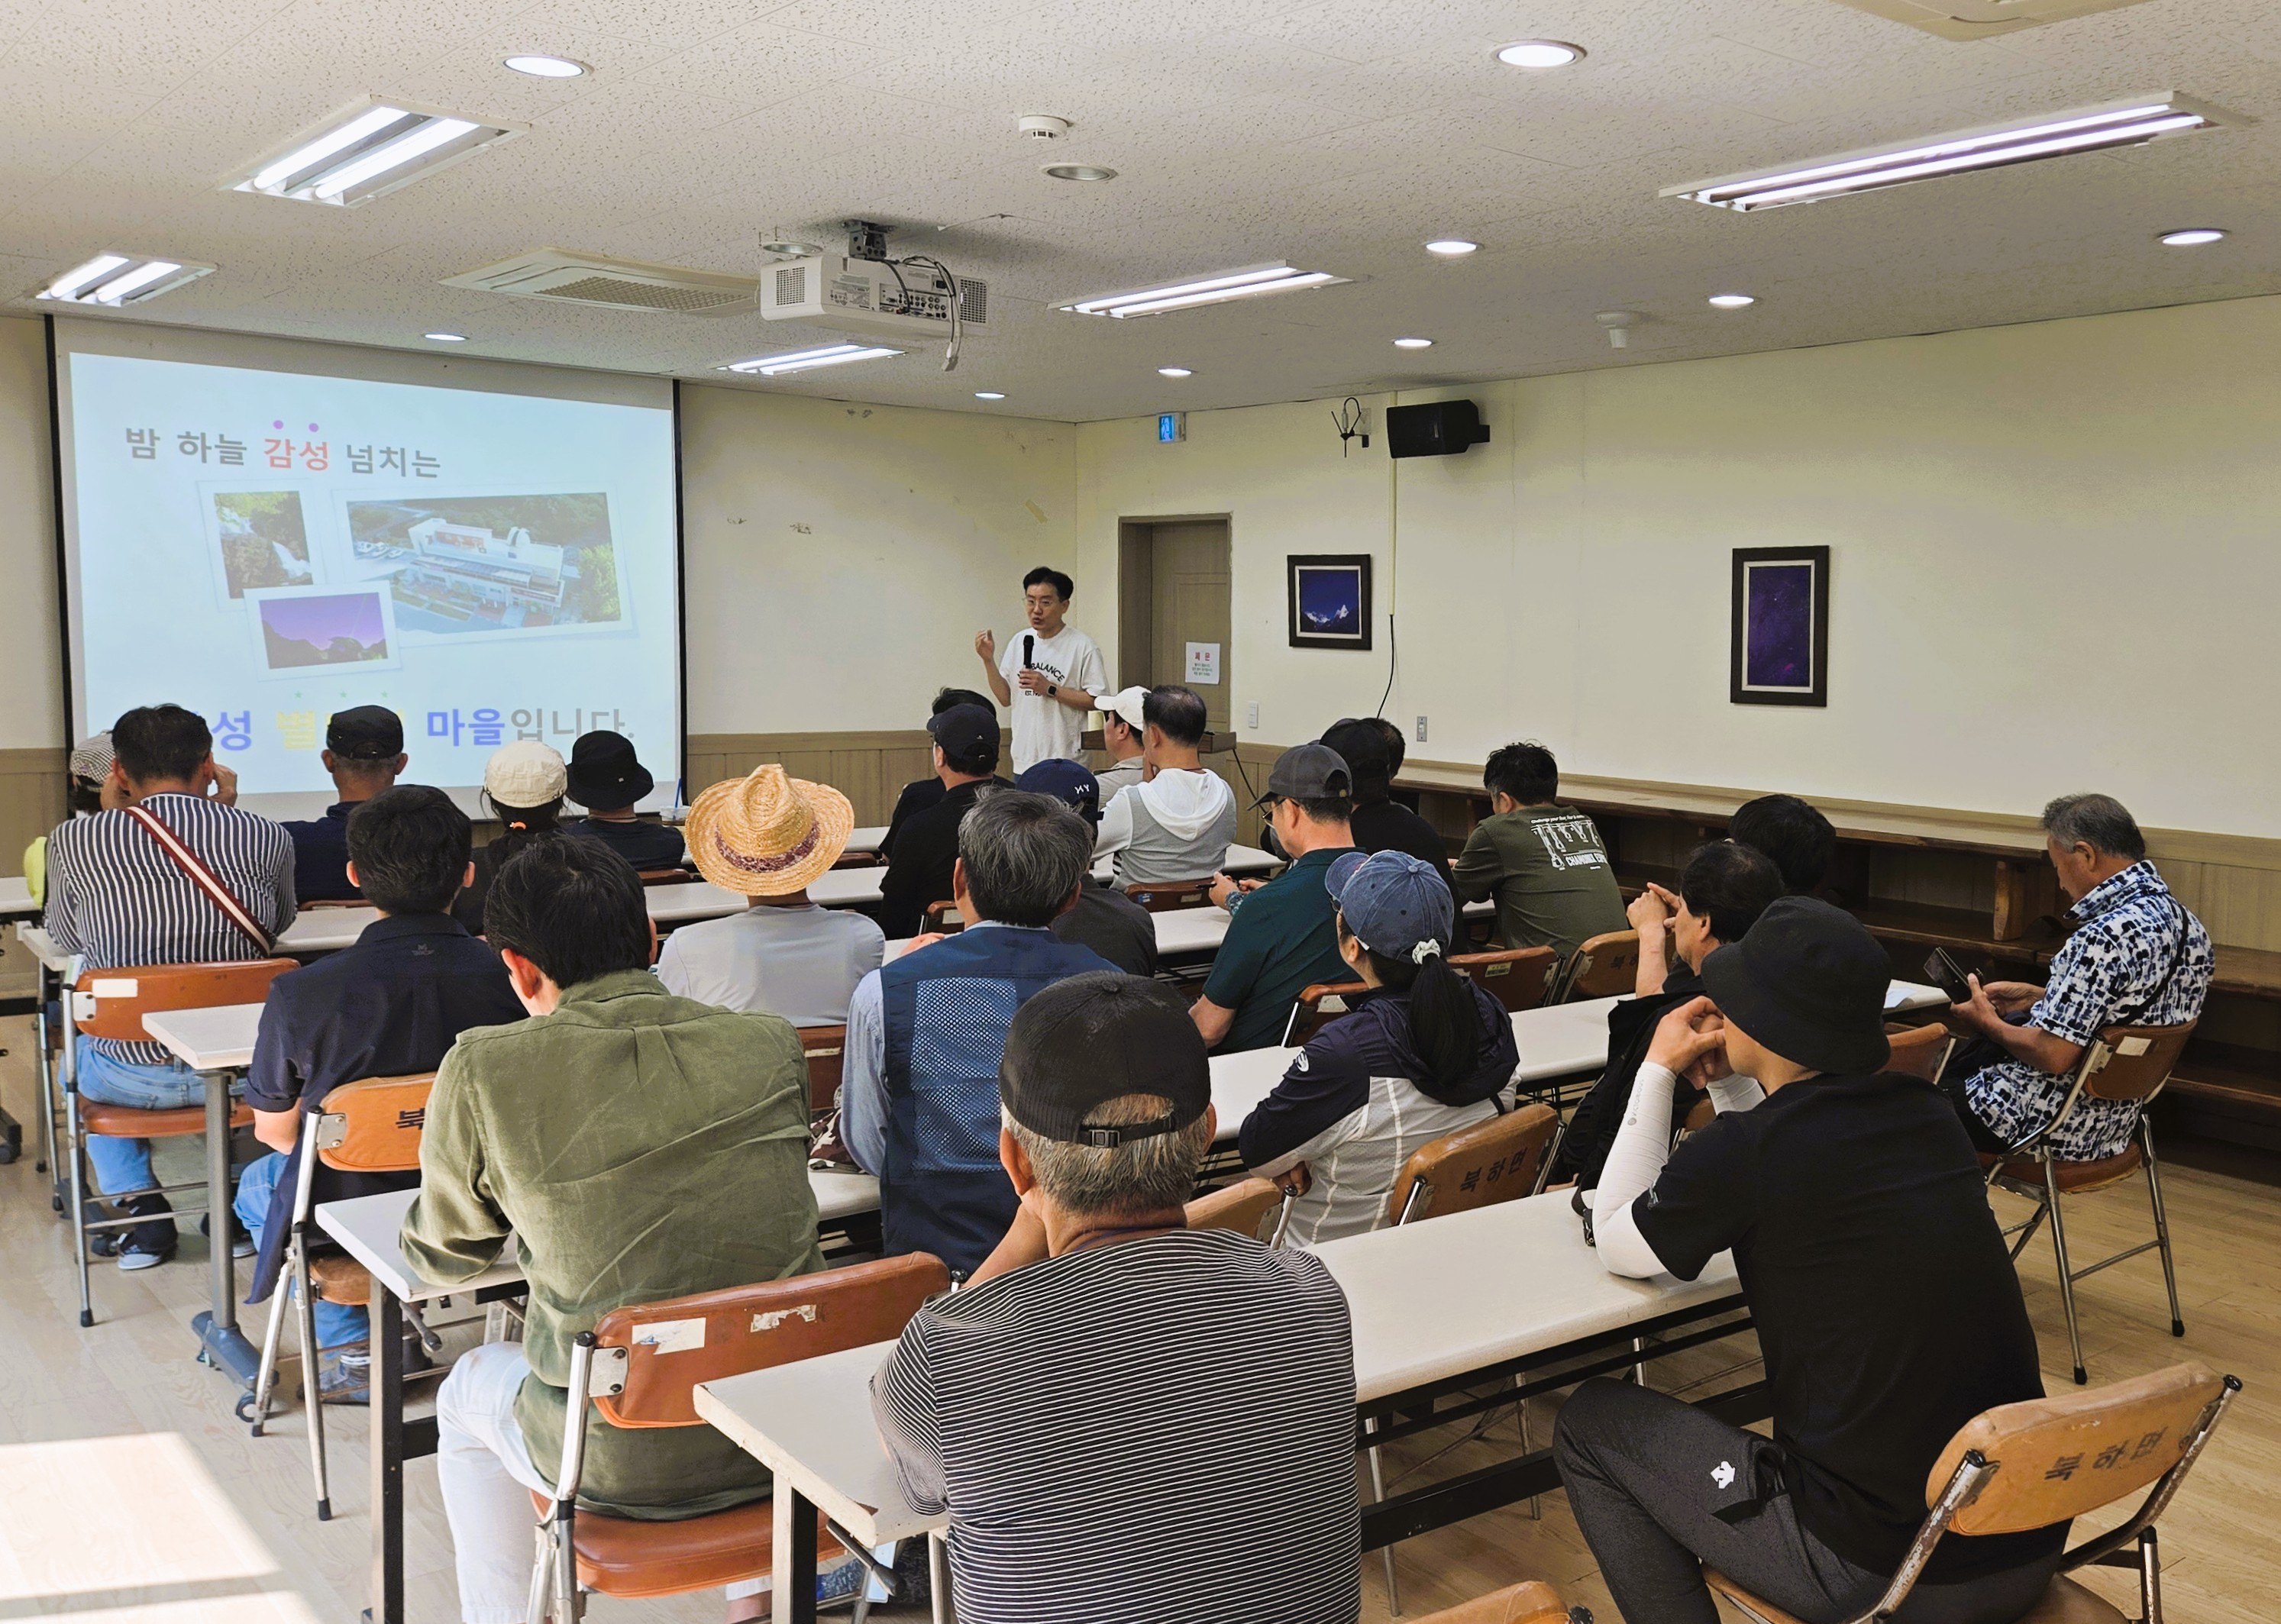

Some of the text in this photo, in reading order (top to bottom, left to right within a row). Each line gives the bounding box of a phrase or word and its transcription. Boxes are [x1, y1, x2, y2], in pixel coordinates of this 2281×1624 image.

[125, 428, 441, 479] 밤 하늘 감성 넘치는
[1031, 662, 1065, 682] BALANCE
[427, 708, 635, 747] 마을입니다.
[1459, 1147, 1528, 1192] 북하면
[2044, 1425, 2169, 1481] 북하면
